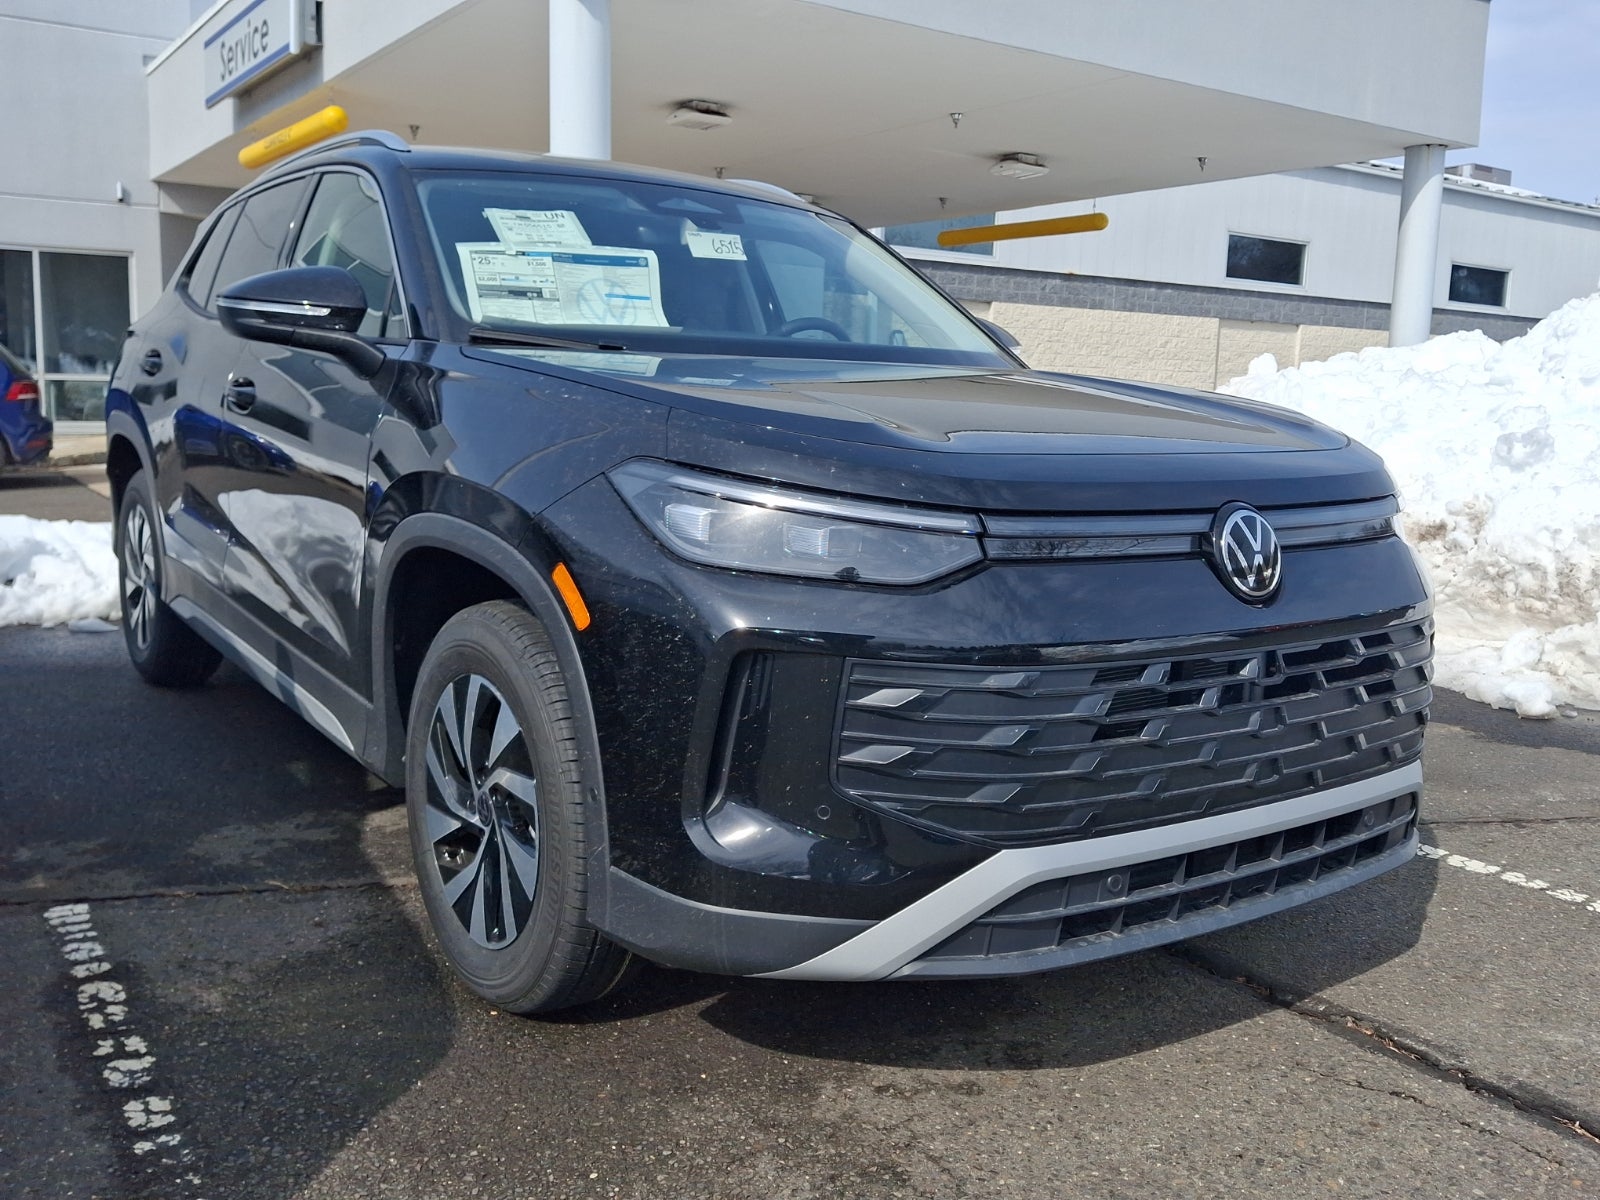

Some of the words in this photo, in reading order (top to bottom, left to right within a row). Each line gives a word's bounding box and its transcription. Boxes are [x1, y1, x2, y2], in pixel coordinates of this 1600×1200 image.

[220, 18, 269, 82] Service
[478, 256, 491, 265] 25
[712, 238, 745, 256] 6515
[1221, 509, 1280, 596] VW
